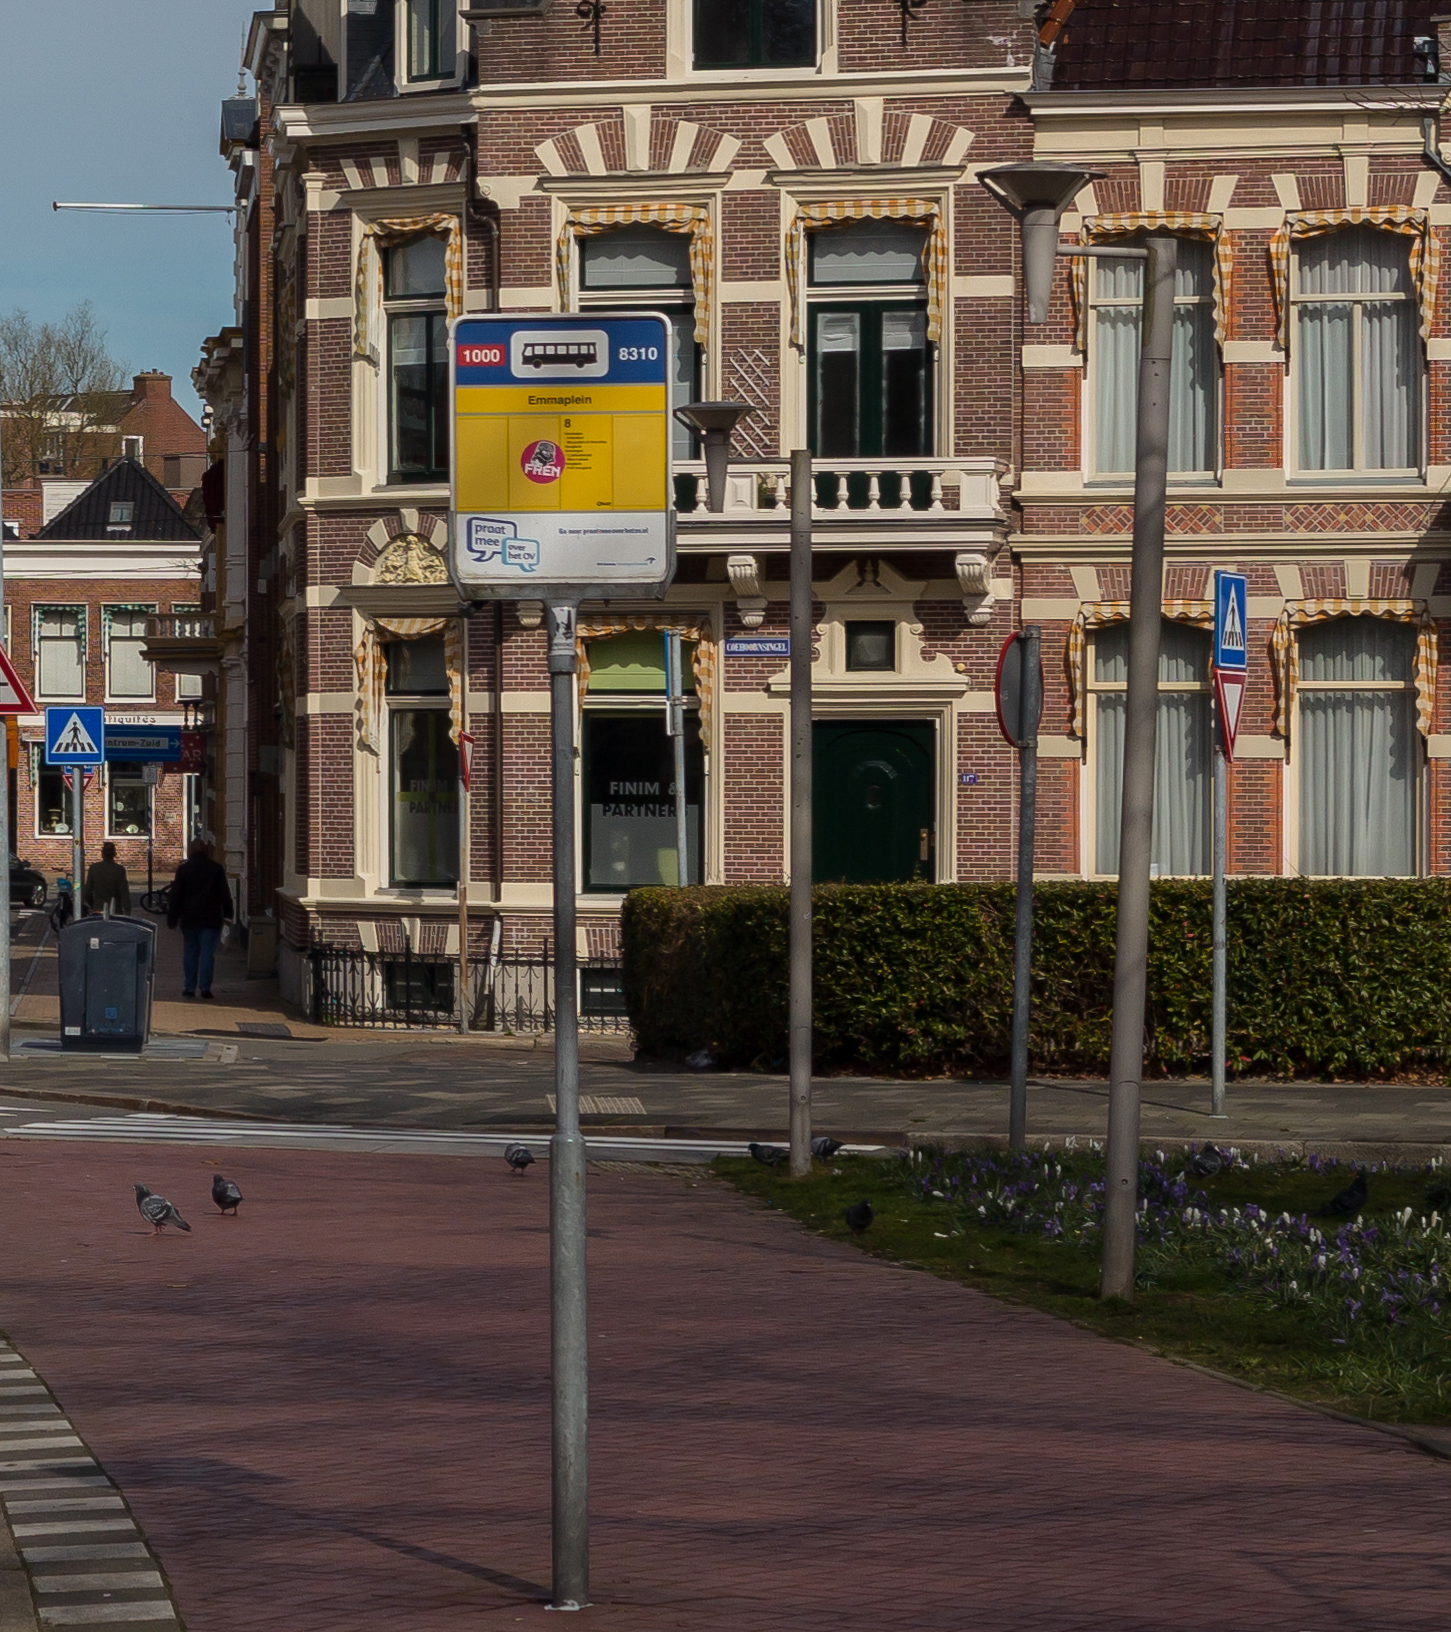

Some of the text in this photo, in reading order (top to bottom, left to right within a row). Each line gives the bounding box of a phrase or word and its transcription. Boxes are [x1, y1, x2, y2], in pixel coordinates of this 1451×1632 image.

[462, 349, 501, 363] 1000
[618, 347, 659, 361] 8310
[528, 395, 592, 407] Emmaplein
[564, 418, 571, 428] 8
[474, 523, 506, 535] praat
[474, 537, 500, 546] mee
[507, 551, 536, 560] het OV
[105, 739, 161, 747] ntrum-Zuid
[181, 749, 202, 762] AR
[609, 781, 660, 796] FINIM
[602, 803, 688, 817] PARTNER
